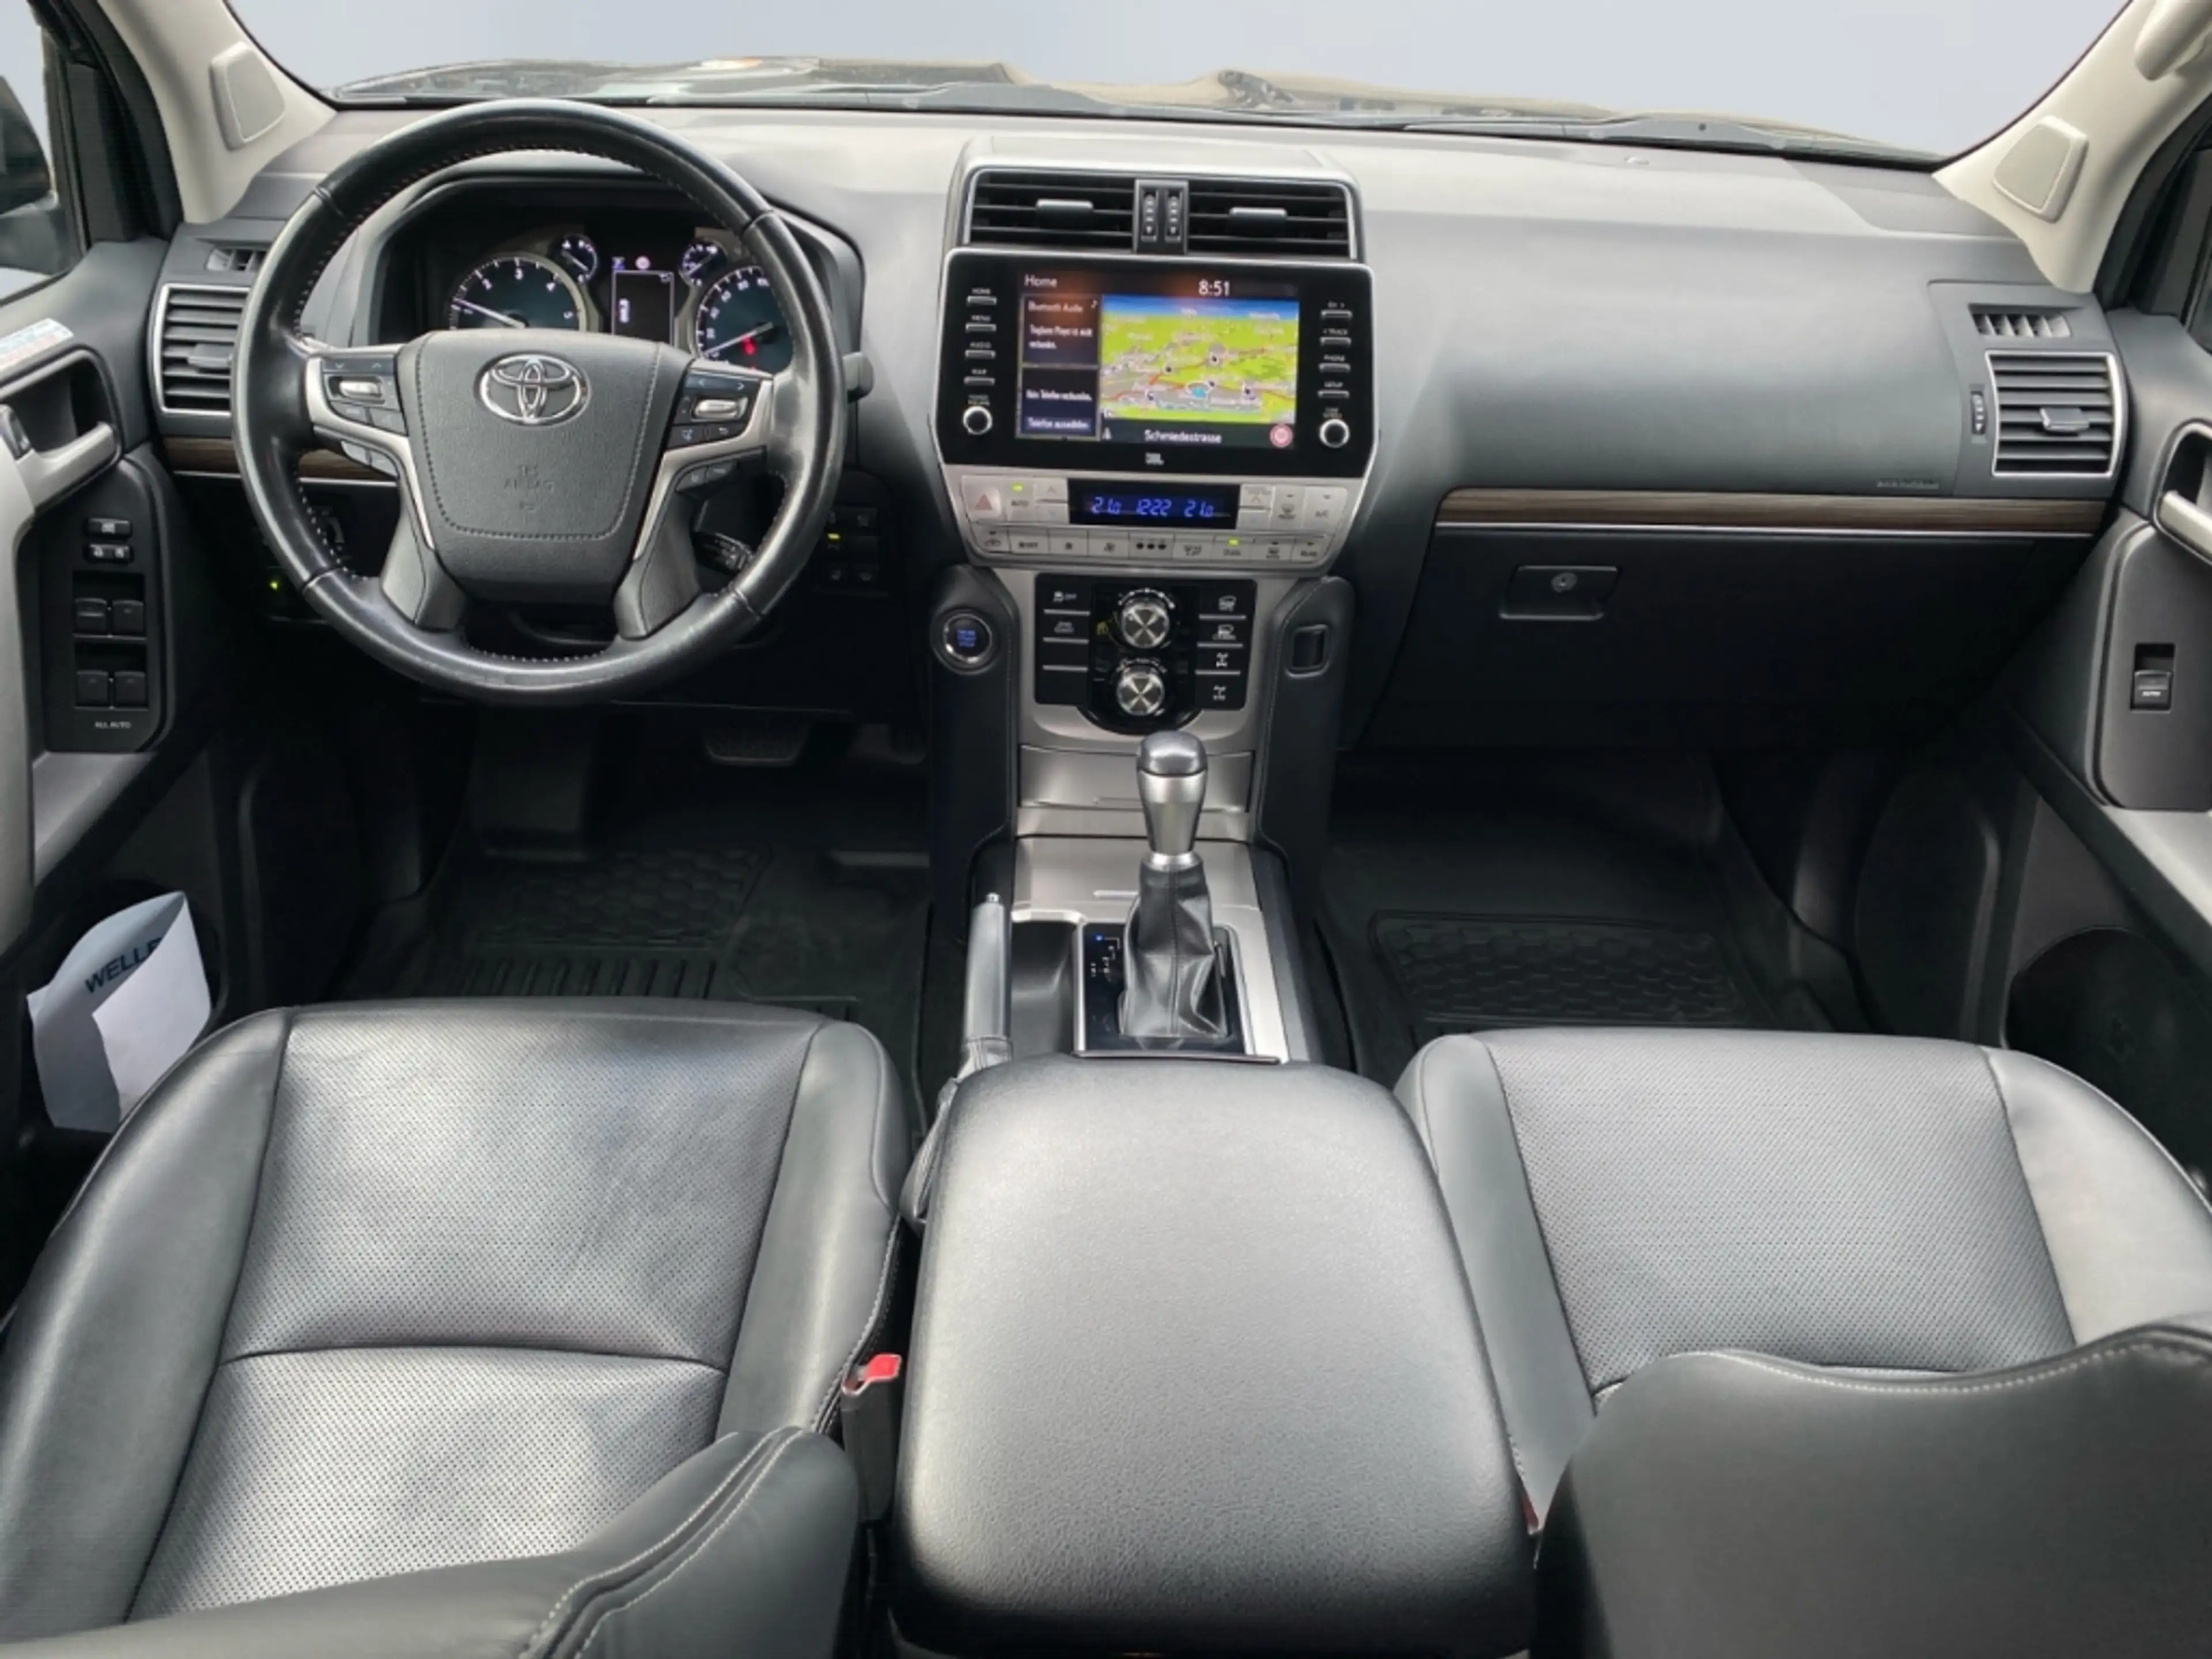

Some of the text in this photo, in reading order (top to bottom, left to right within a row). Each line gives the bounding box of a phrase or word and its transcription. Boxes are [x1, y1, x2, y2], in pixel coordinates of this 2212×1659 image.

[1024, 274, 1058, 287] Home
[1198, 279, 1230, 297] 8:51
[1144, 429, 1222, 444] Schmiedestrasse
